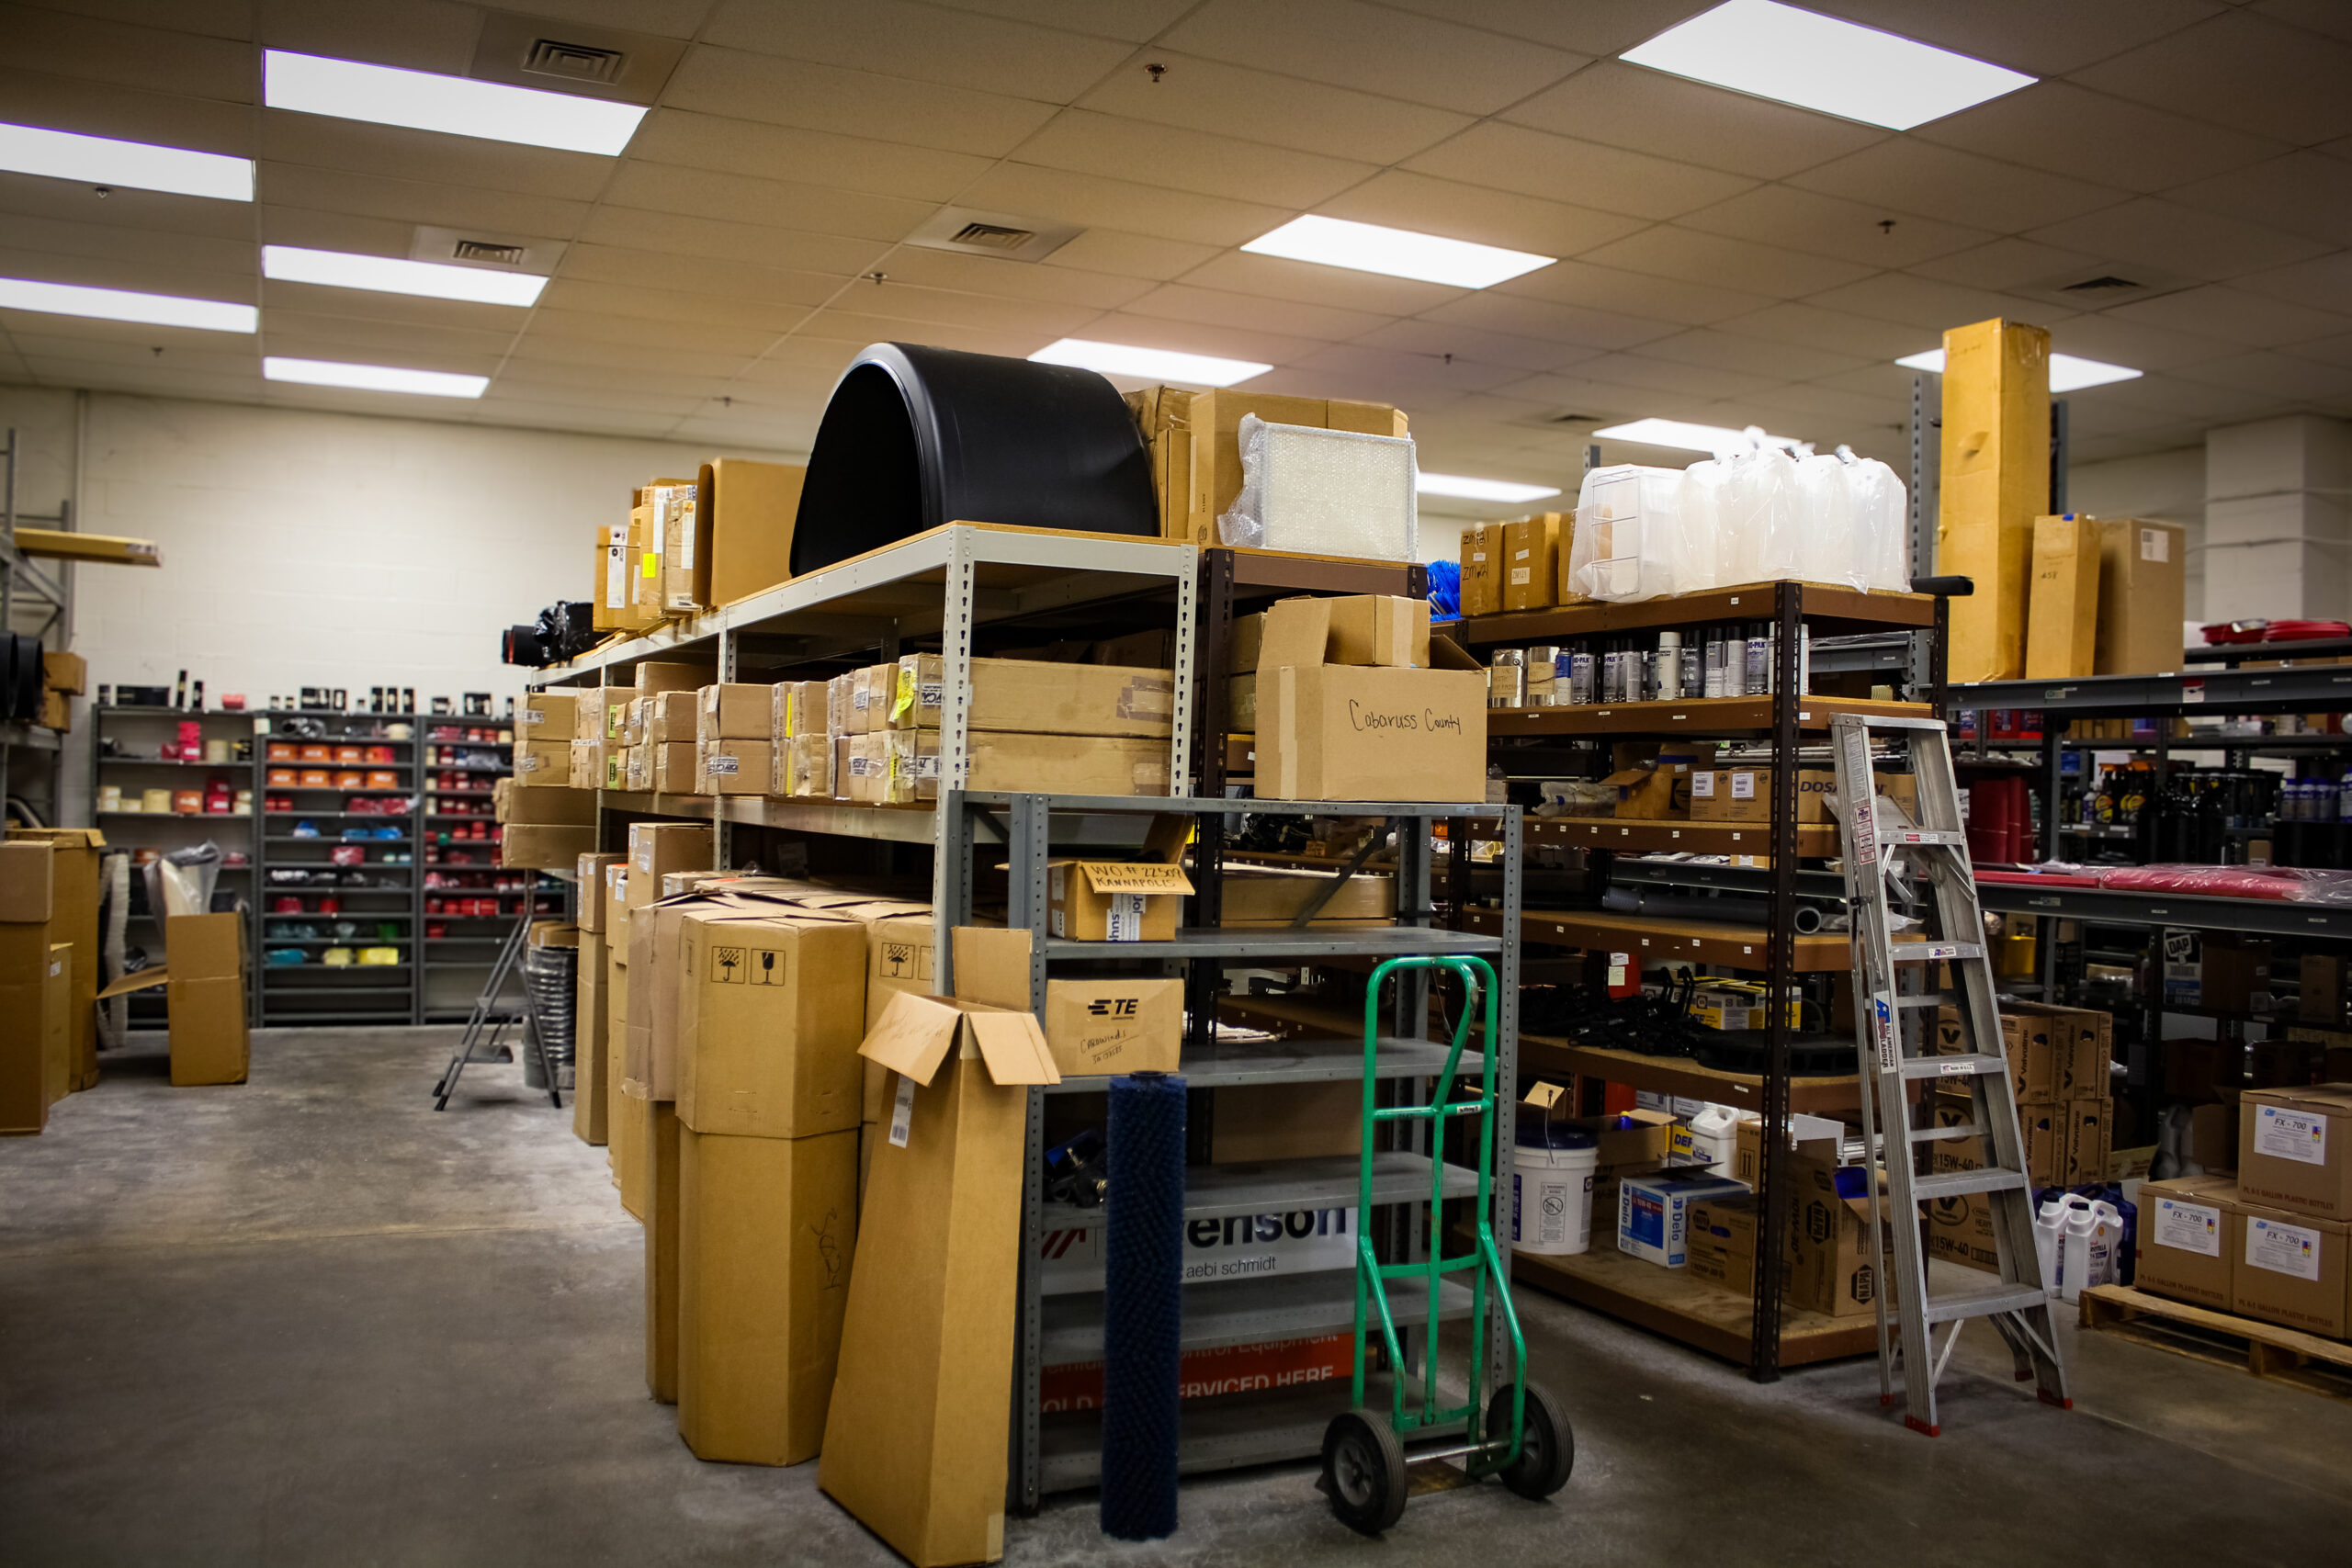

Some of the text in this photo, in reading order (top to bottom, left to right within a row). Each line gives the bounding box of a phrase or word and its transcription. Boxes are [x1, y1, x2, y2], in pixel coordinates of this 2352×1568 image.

[1349, 699, 1462, 735] Cabaruss County
[1095, 877, 1176, 888] KANNAPOLIS
[2167, 937, 2189, 954] DAP
[1114, 998, 1139, 1015] TE
[2274, 1118, 2286, 1127] FX
[2292, 1121, 2307, 1130] 700
[1939, 1154, 1973, 1170] 15W-40
[1622, 1198, 1630, 1224] Delo
[2172, 1211, 2183, 1219] FX
[2188, 1213, 2202, 1223] 700
[1185, 1207, 1347, 1247] enson
[1671, 1213, 1683, 1241] Delo
[1935, 1237, 1969, 1257] 15W-40
[2266, 1231, 2278, 1240] FX
[2285, 1235, 2300, 1245] 700
[1186, 1256, 1276, 1278] aebi schmidt
[1859, 1270, 1871, 1298] NAPA
